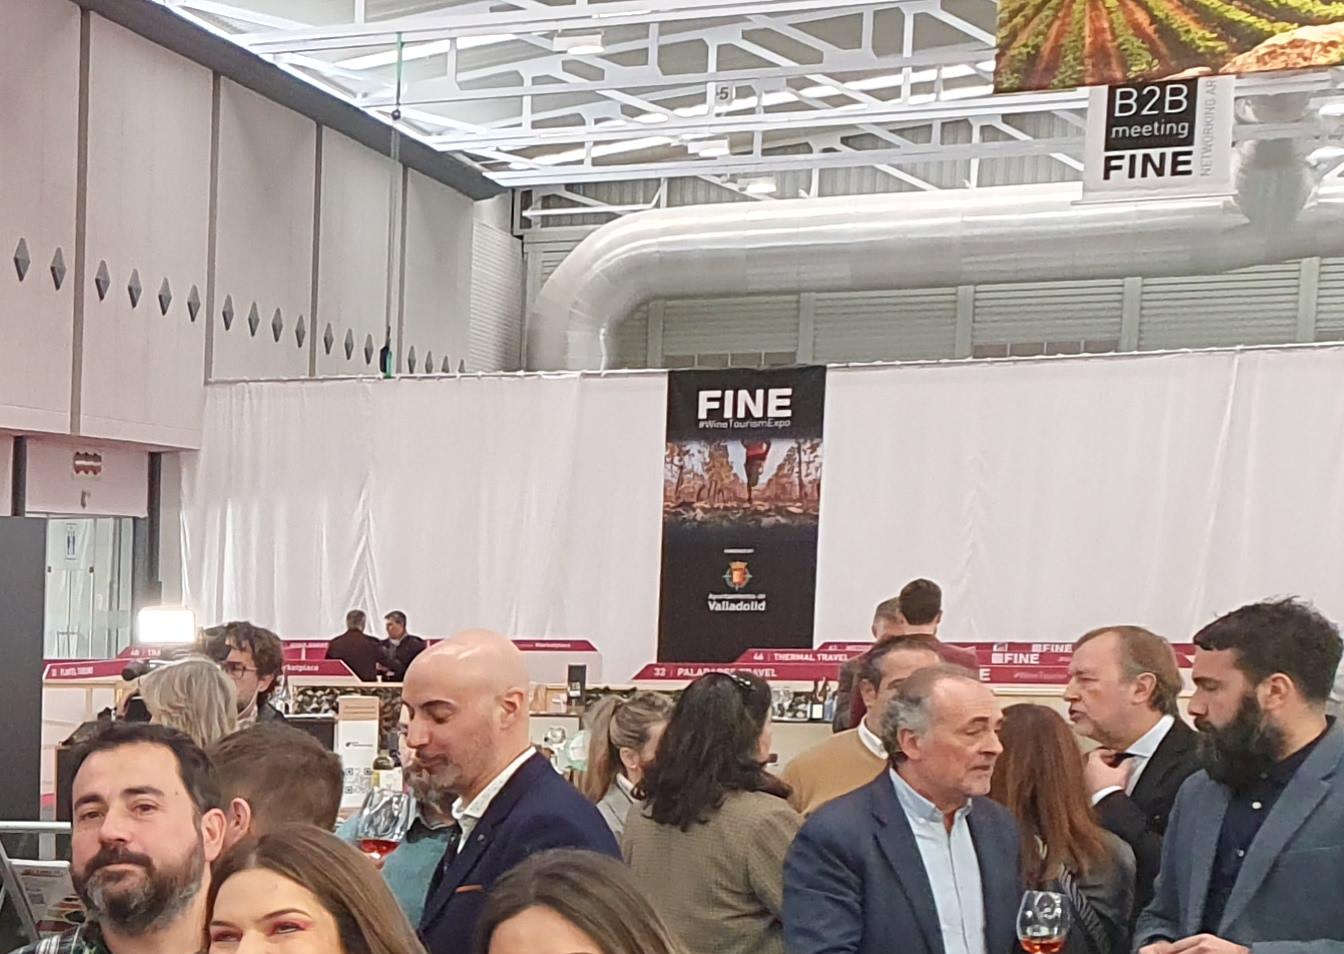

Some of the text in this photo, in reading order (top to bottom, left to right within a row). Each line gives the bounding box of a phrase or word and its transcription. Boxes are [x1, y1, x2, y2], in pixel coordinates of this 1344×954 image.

[1114, 84, 1188, 117] B2B
[1111, 119, 1189, 139] meeting
[1103, 151, 1193, 180] FINE
[698, 388, 792, 419] FINE
[698, 418, 791, 429] #WineTourismExpo
[708, 600, 766, 611] Valladolid
[1004, 653, 1040, 664] FINE
